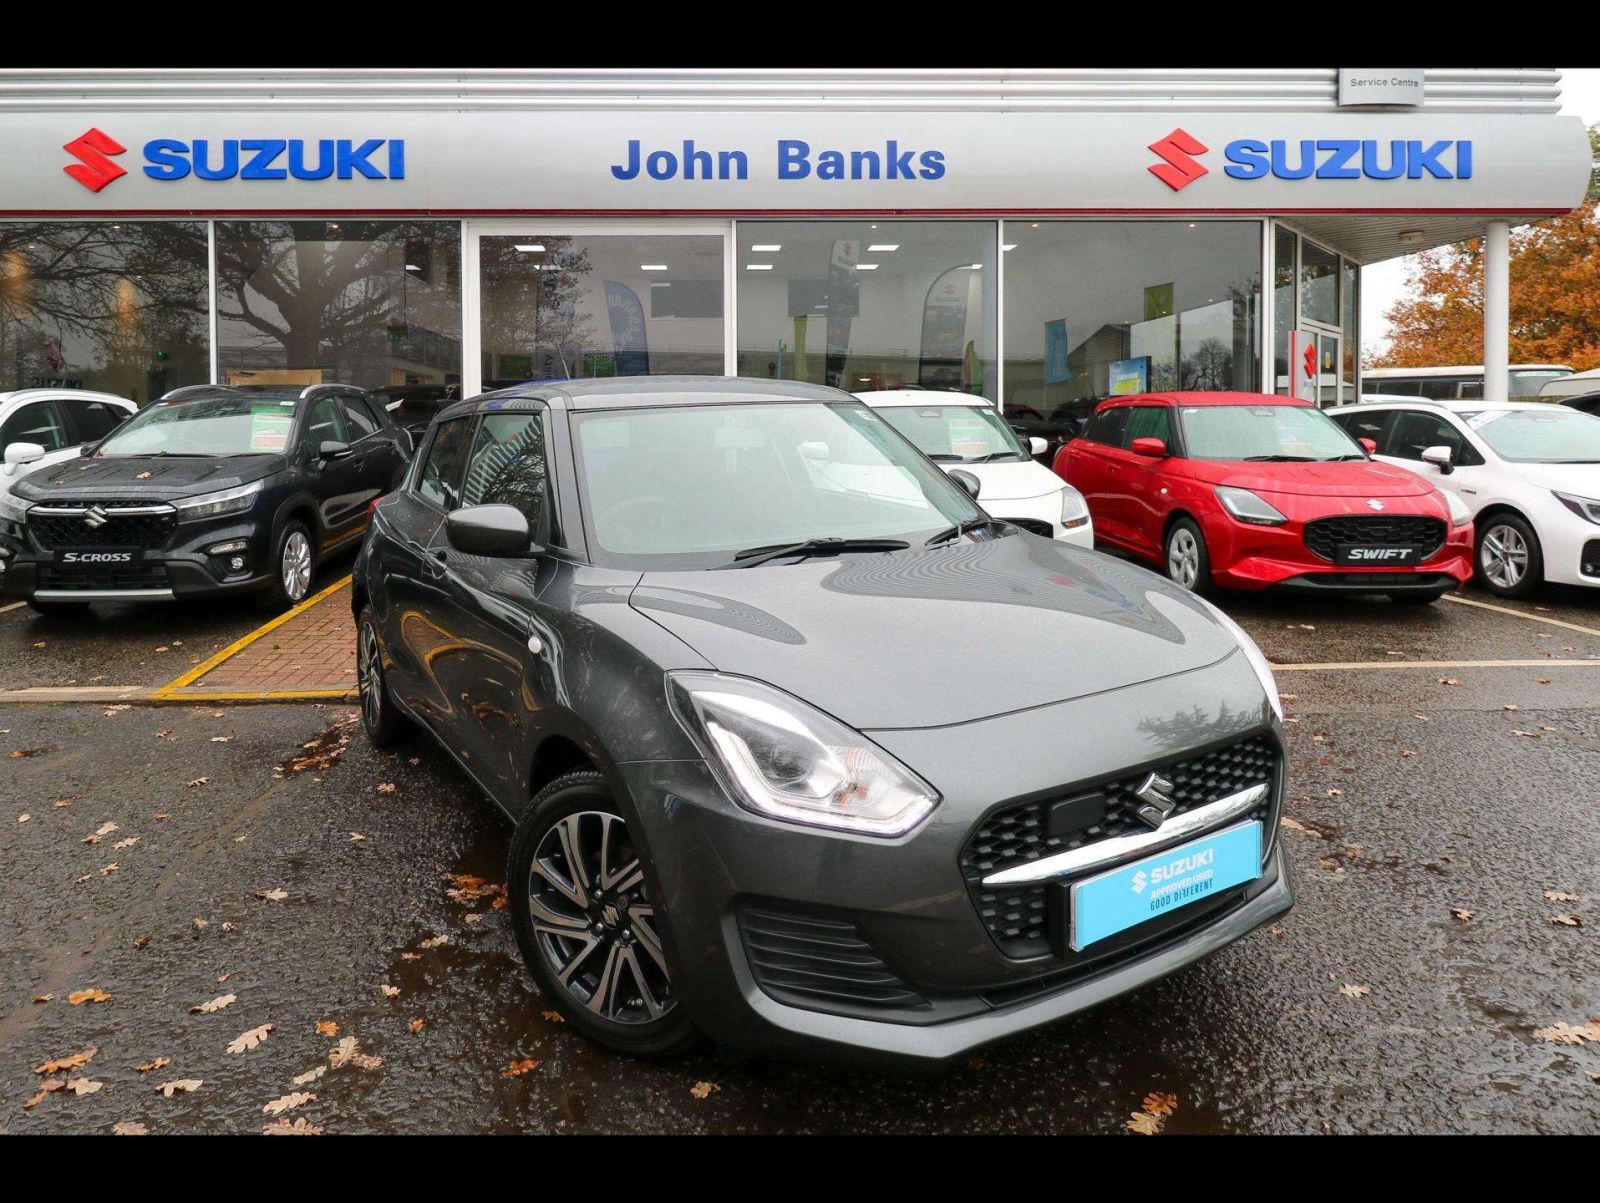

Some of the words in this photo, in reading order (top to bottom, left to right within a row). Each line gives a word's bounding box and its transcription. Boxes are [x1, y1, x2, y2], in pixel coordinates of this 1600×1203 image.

[1351, 78, 1387, 87] Service
[1391, 78, 1418, 87] Centre
[143, 139, 405, 181] SUZUKI
[611, 140, 748, 180] John
[778, 140, 946, 180] Banks
[1223, 139, 1472, 180] SUZUKI
[1348, 548, 1412, 559] SWIFT
[1151, 848, 1214, 884] SUZUKI
[1150, 894, 1171, 911] GOOD
[1173, 878, 1213, 902] DIFFERENT
[1151, 876, 1192, 899] APPROVED
[1192, 869, 1214, 883] USED
